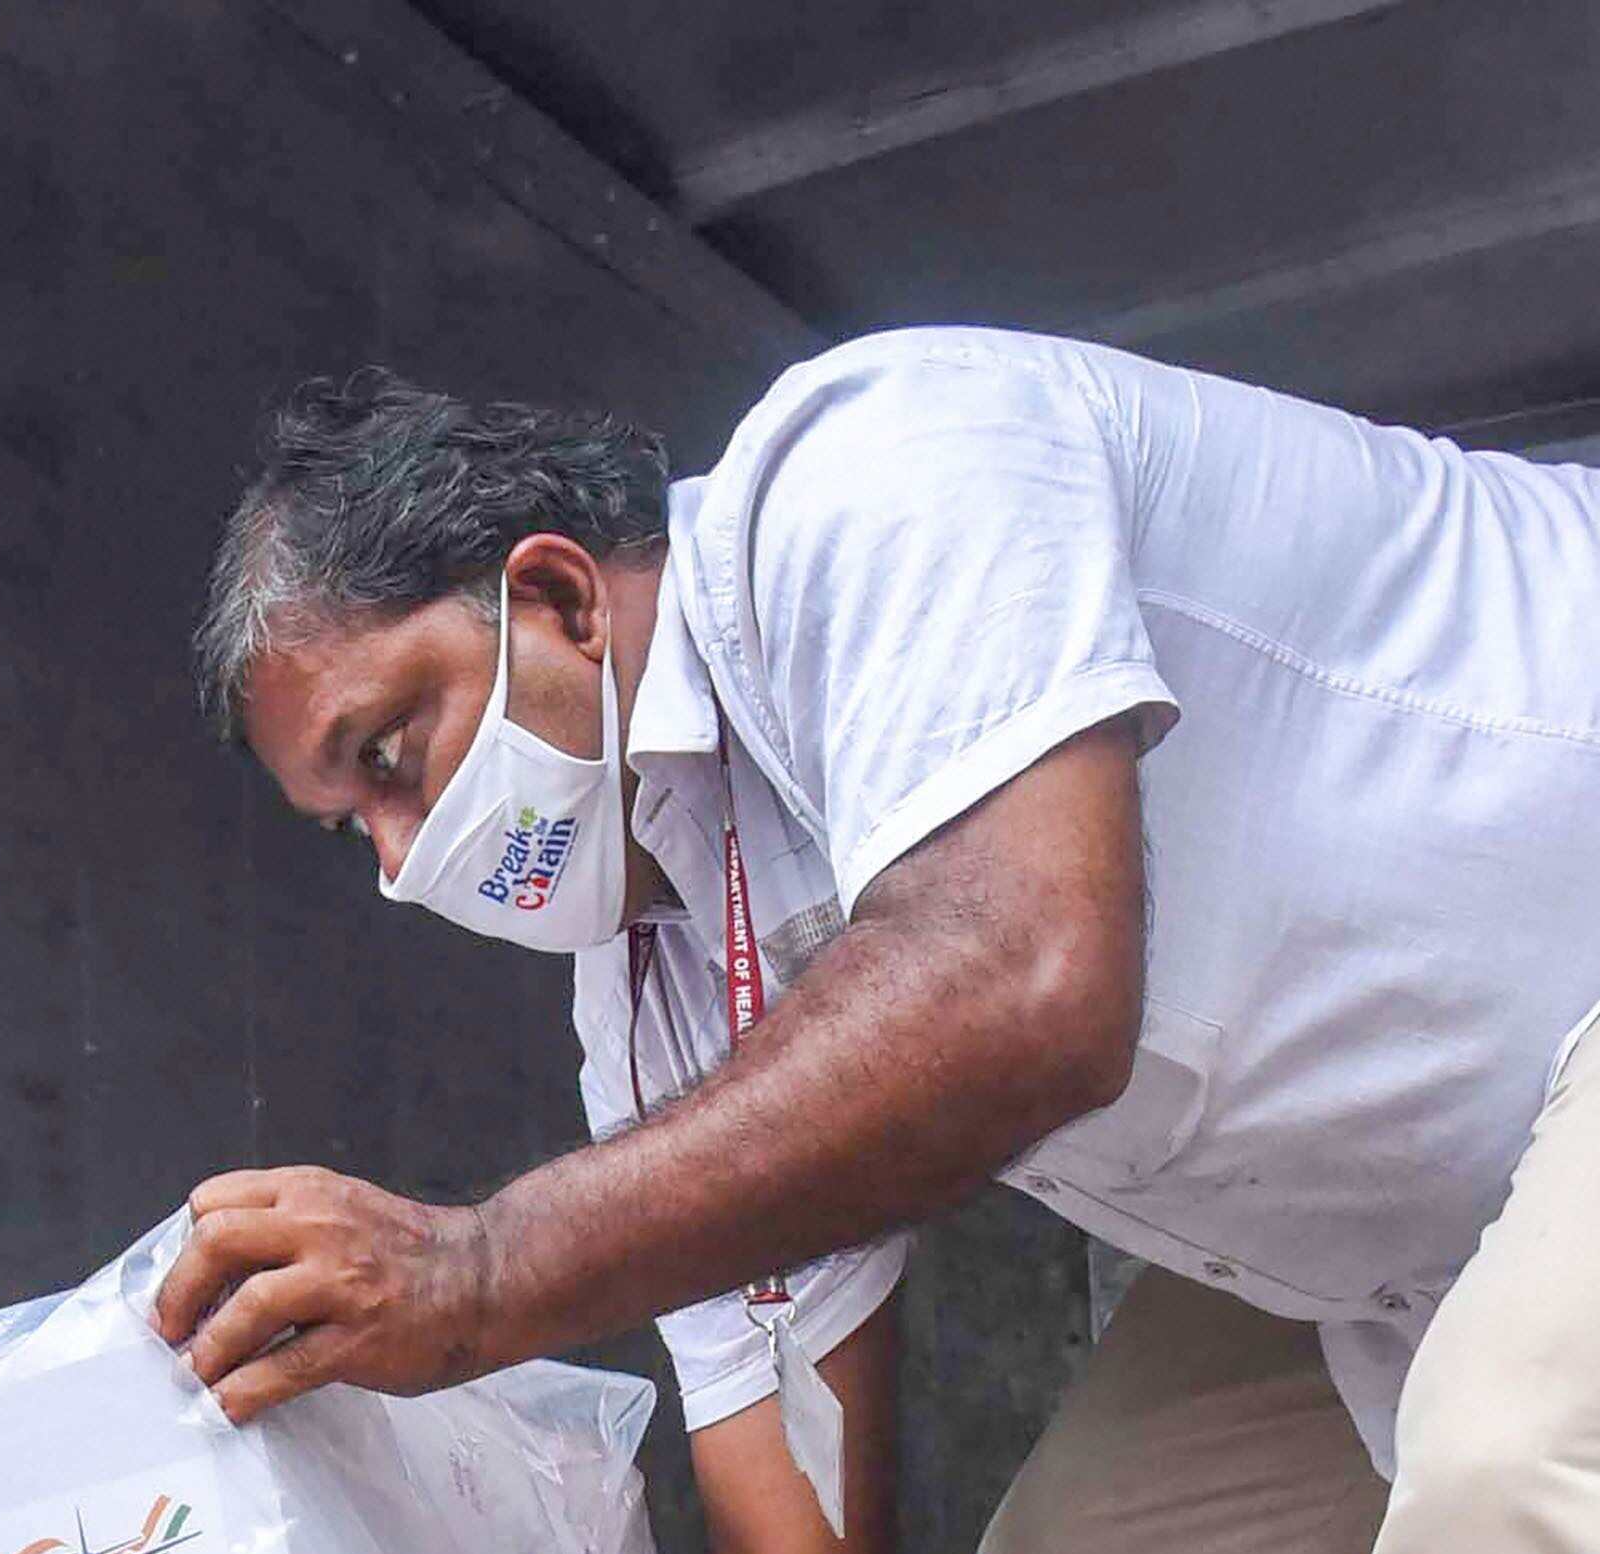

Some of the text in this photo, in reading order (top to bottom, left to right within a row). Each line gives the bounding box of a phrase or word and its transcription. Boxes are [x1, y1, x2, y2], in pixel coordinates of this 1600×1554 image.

[478, 827, 533, 904] Break
[512, 817, 576, 910] Chain
[734, 960, 750, 980] OF
